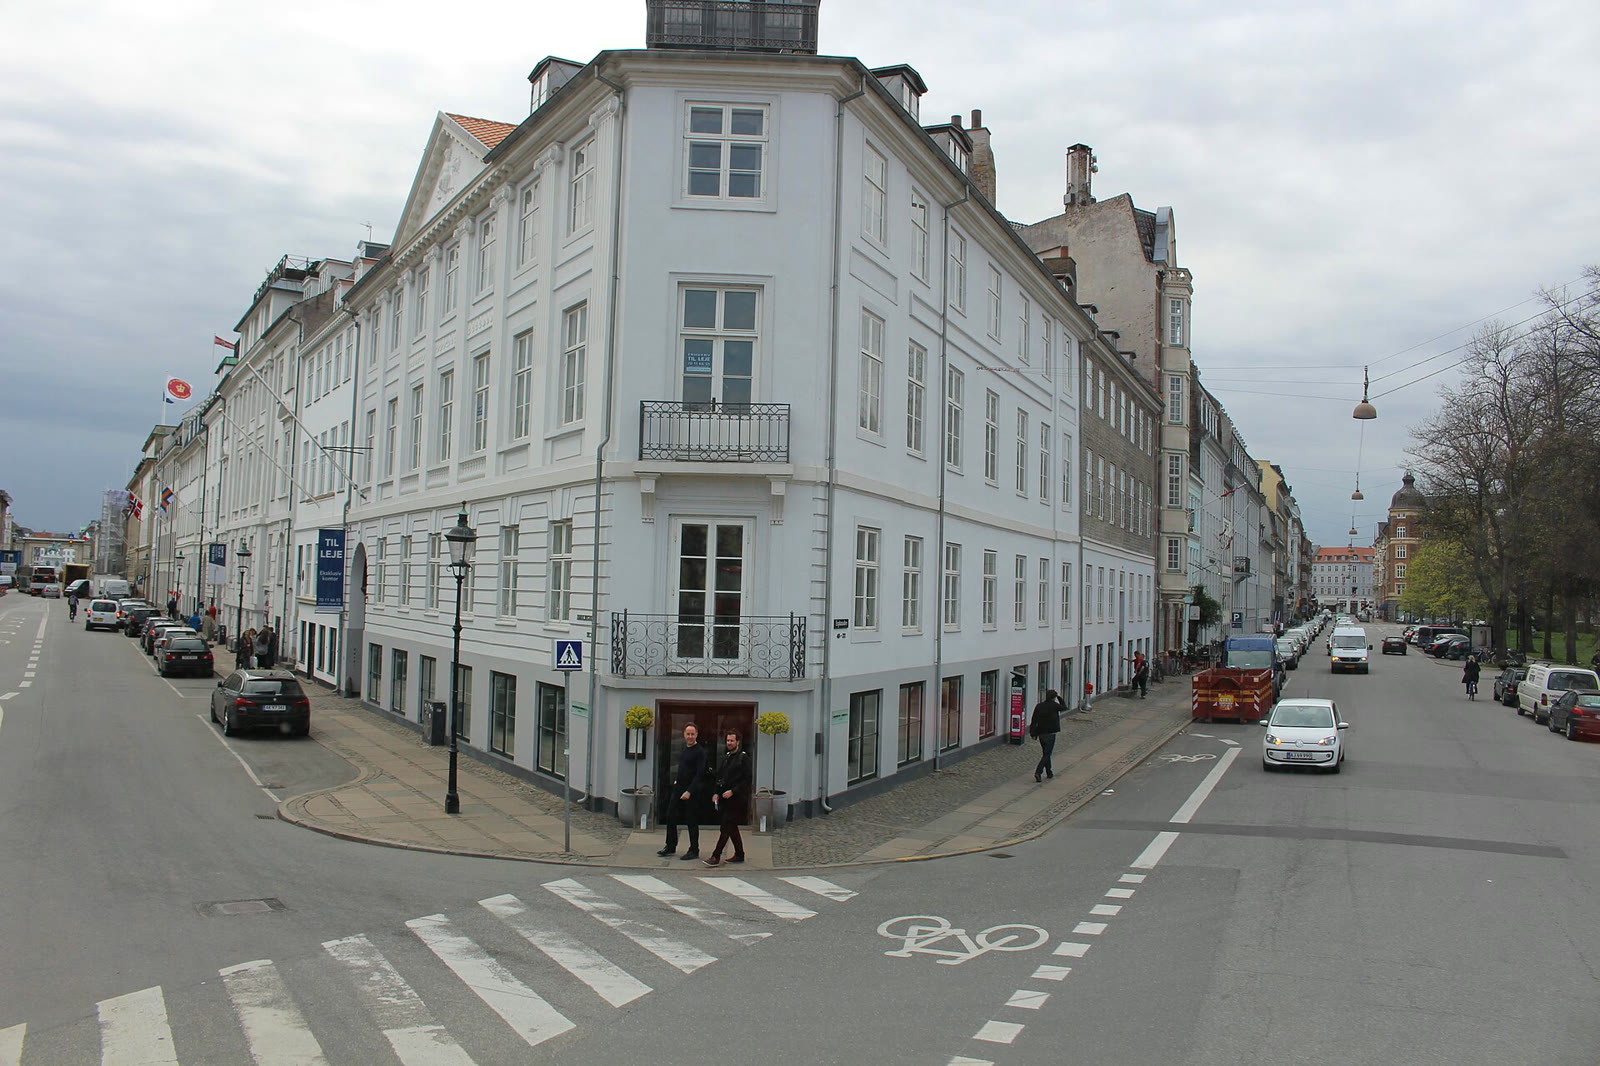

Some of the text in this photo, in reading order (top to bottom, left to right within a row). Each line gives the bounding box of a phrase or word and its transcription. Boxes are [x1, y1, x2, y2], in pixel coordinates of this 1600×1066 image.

[324, 538, 340, 546] TIL
[320, 550, 343, 558] LEJE
[1234, 614, 1240, 622] P
